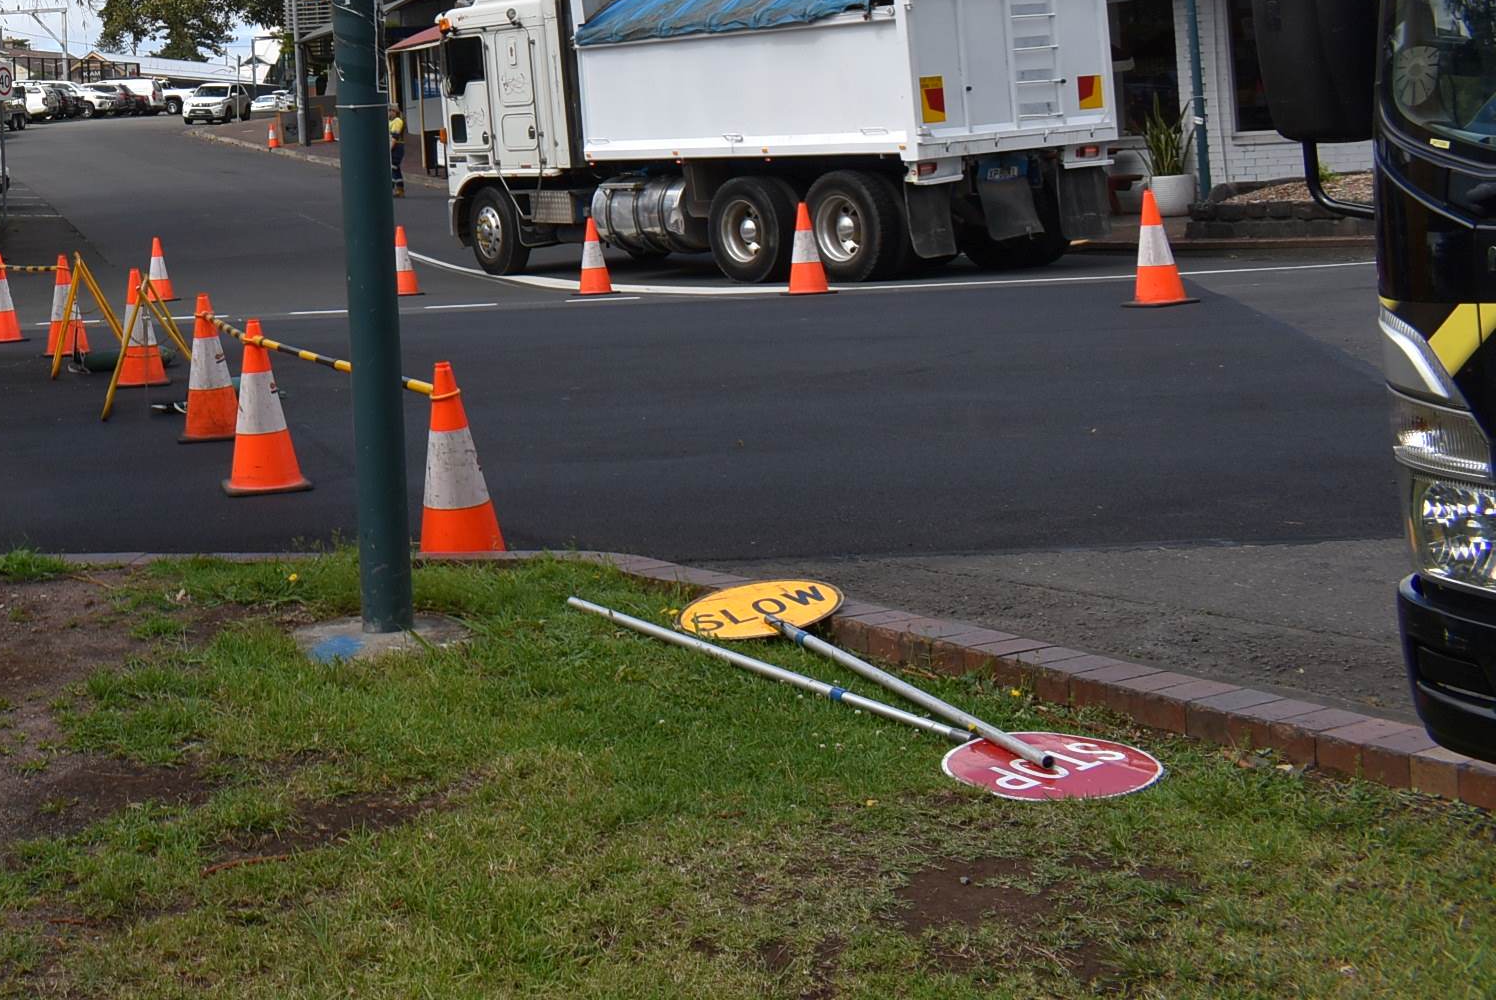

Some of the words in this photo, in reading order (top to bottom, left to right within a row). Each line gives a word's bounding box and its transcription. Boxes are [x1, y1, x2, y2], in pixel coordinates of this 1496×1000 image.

[0, 74, 10, 88] 40
[691, 585, 826, 632] SLOW
[989, 741, 1126, 790] STOP
